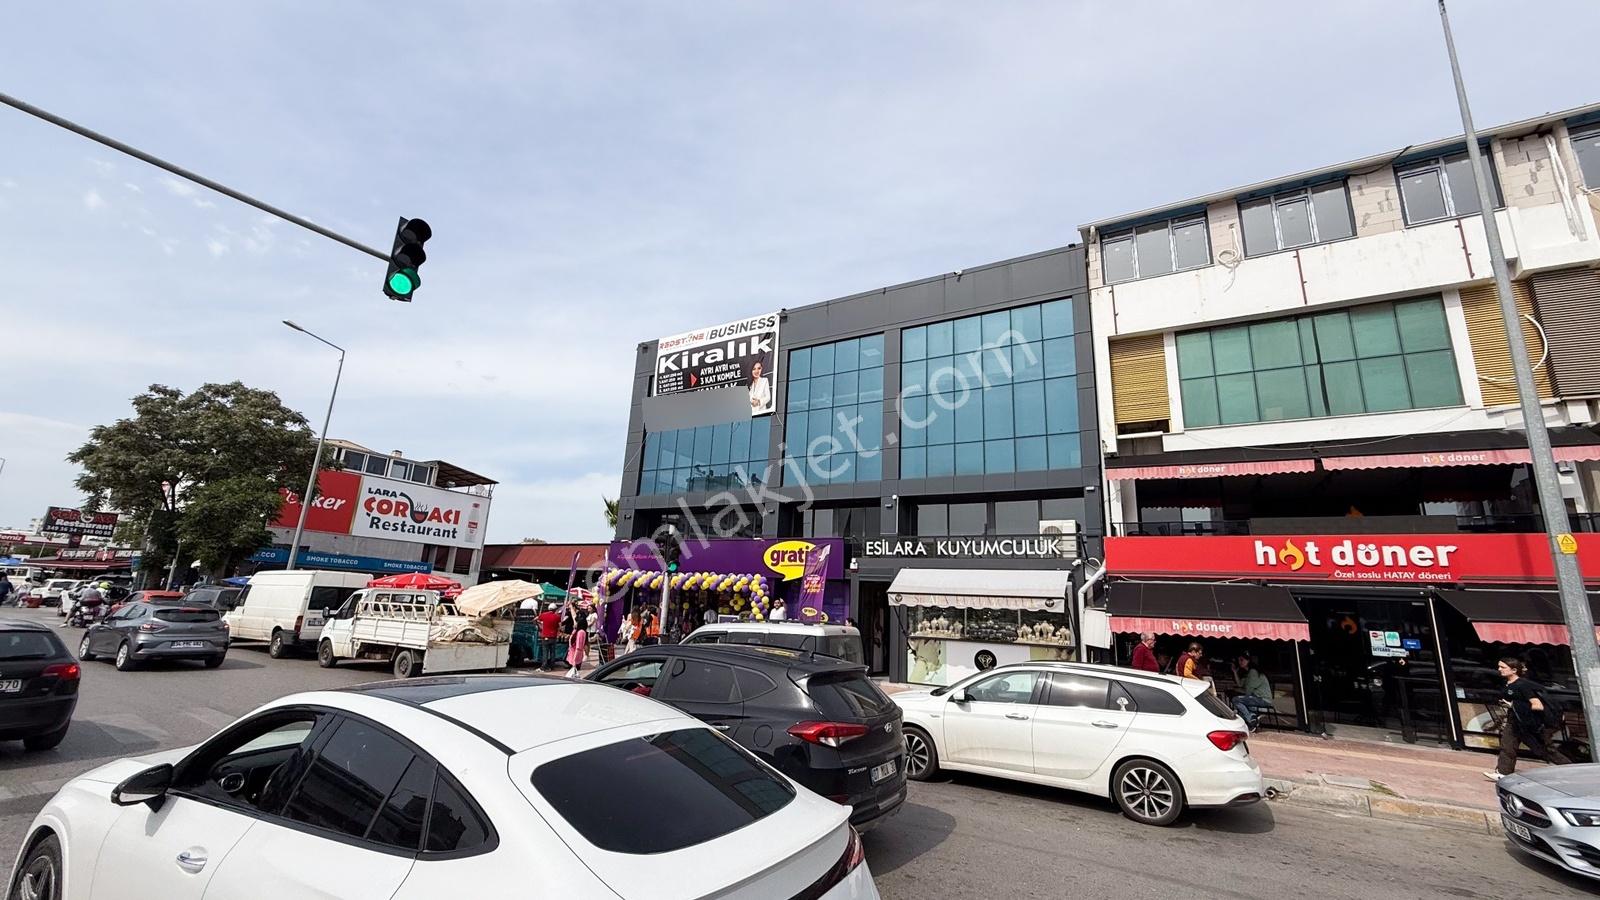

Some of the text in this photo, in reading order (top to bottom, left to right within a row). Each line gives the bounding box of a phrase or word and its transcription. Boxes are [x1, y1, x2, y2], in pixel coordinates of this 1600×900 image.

[709, 315, 776, 340] BUSINESS
[659, 335, 773, 374] Kiralık
[700, 367, 714, 376] AYRI
[715, 363, 729, 374] AYRI
[700, 369, 741, 385] 3 KAT KOMPLE
[368, 487, 398, 499] LARA
[55, 519, 114, 531] Restaurant
[369, 516, 458, 540] Restaurant
[866, 539, 1062, 556] ESİLARA KUYUMCULUK
[1331, 540, 1458, 567] döner
[306, 555, 359, 566] SMOKE TOBACCO
[383, 562, 428, 572] SMOKE TOBACCO
[1334, 570, 1452, 580] Özel soslu HATAY döneri
